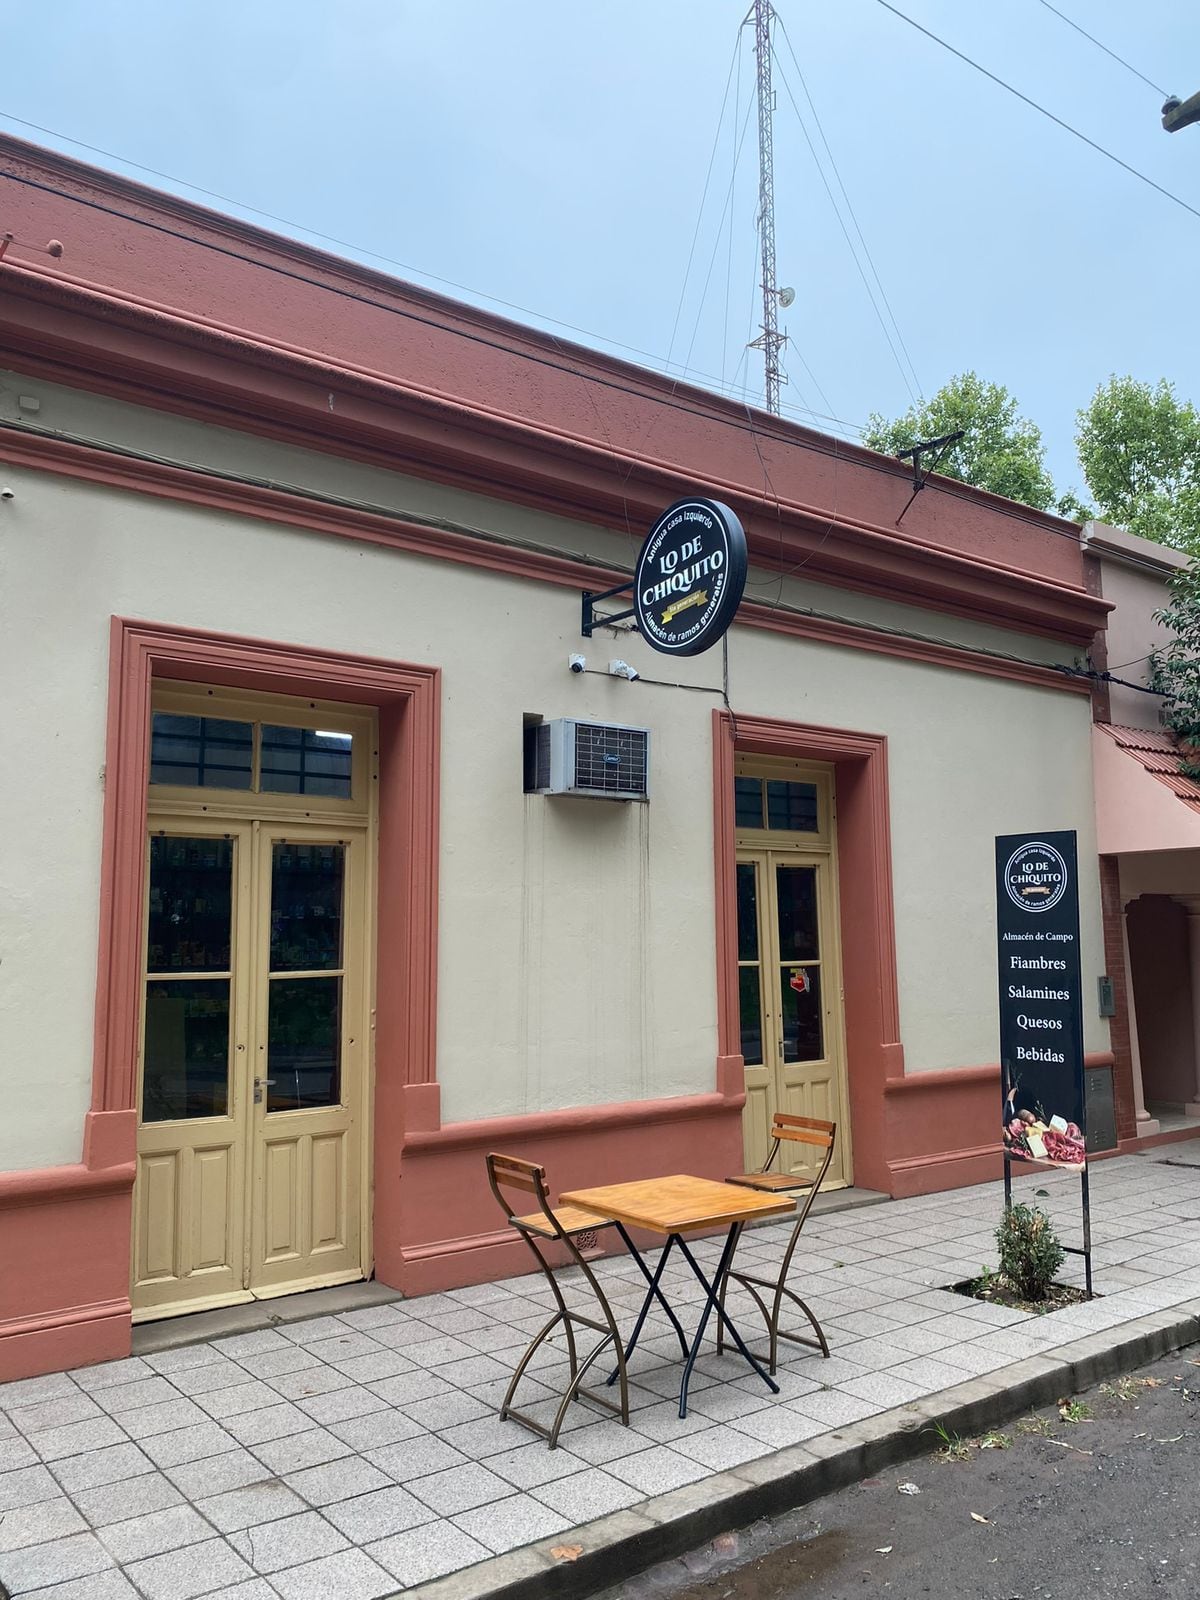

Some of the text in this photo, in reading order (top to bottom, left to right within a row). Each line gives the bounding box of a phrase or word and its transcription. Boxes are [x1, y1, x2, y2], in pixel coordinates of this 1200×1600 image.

[646, 510, 713, 564] Antigua casa Izquierdo
[660, 535, 703, 575] LO DE
[643, 550, 724, 606] CHIQUITO
[644, 572, 724, 642] Almacén de ramos generales
[1022, 862, 1049, 874] LO DE
[1010, 873, 1061, 885] CHIQUITO
[1002, 932, 1074, 943] Almacén de Campo
[1010, 956, 1067, 970] Fiambres
[1008, 985, 1070, 1001] Salamines
[1016, 1014, 1063, 1030] Quesos
[1016, 1046, 1065, 1064] Bebidas
